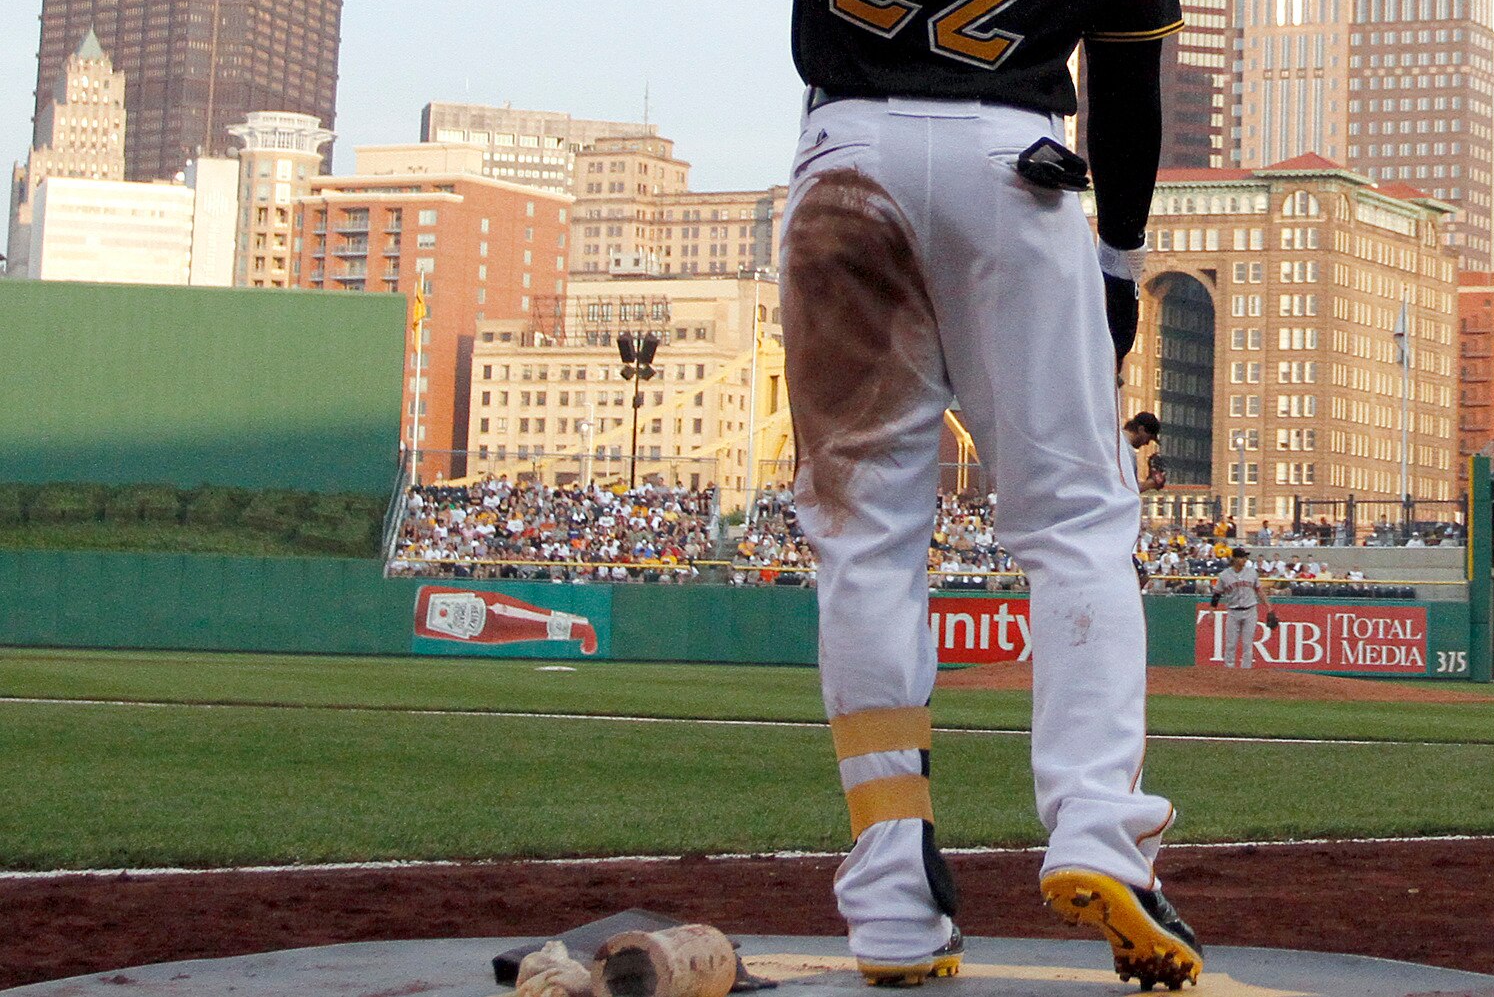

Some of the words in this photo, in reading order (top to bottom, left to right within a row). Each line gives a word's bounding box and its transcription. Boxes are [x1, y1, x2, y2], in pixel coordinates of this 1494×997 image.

[1335, 613, 1422, 640] TOTAL
[1340, 640, 1424, 667] MEDIA
[1436, 651, 1467, 673] 375
